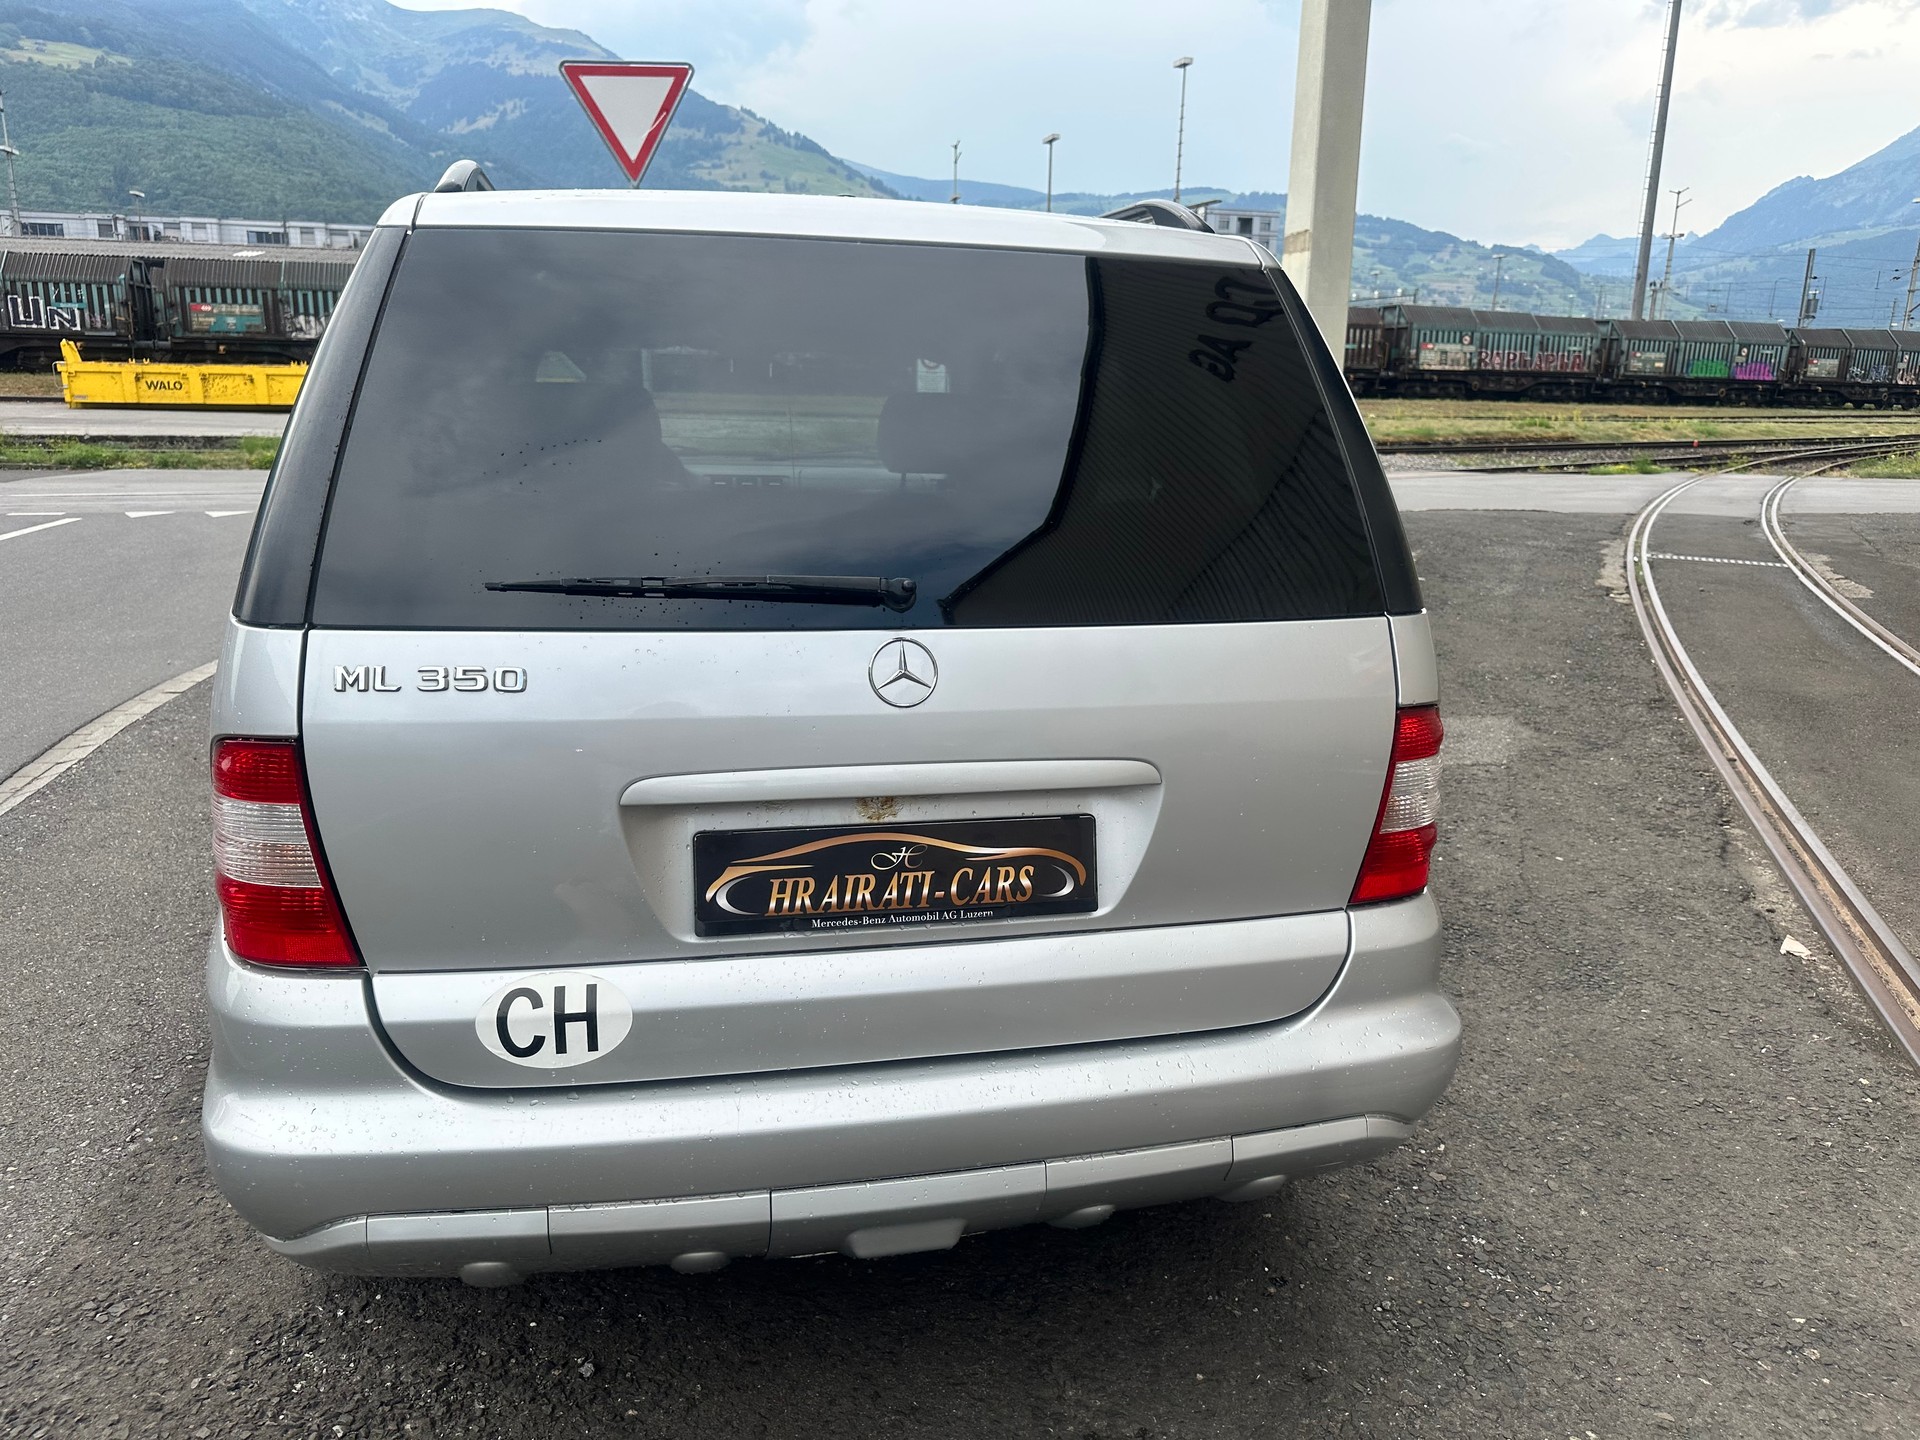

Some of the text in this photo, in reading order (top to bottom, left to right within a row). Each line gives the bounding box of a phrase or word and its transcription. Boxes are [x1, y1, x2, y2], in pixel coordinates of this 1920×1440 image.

[145, 380, 183, 391] WALO
[334, 665, 528, 693] ML 350
[811, 909, 994, 929] Mercedes-Benz Automobil AG Luzern
[496, 983, 599, 1058] CH
